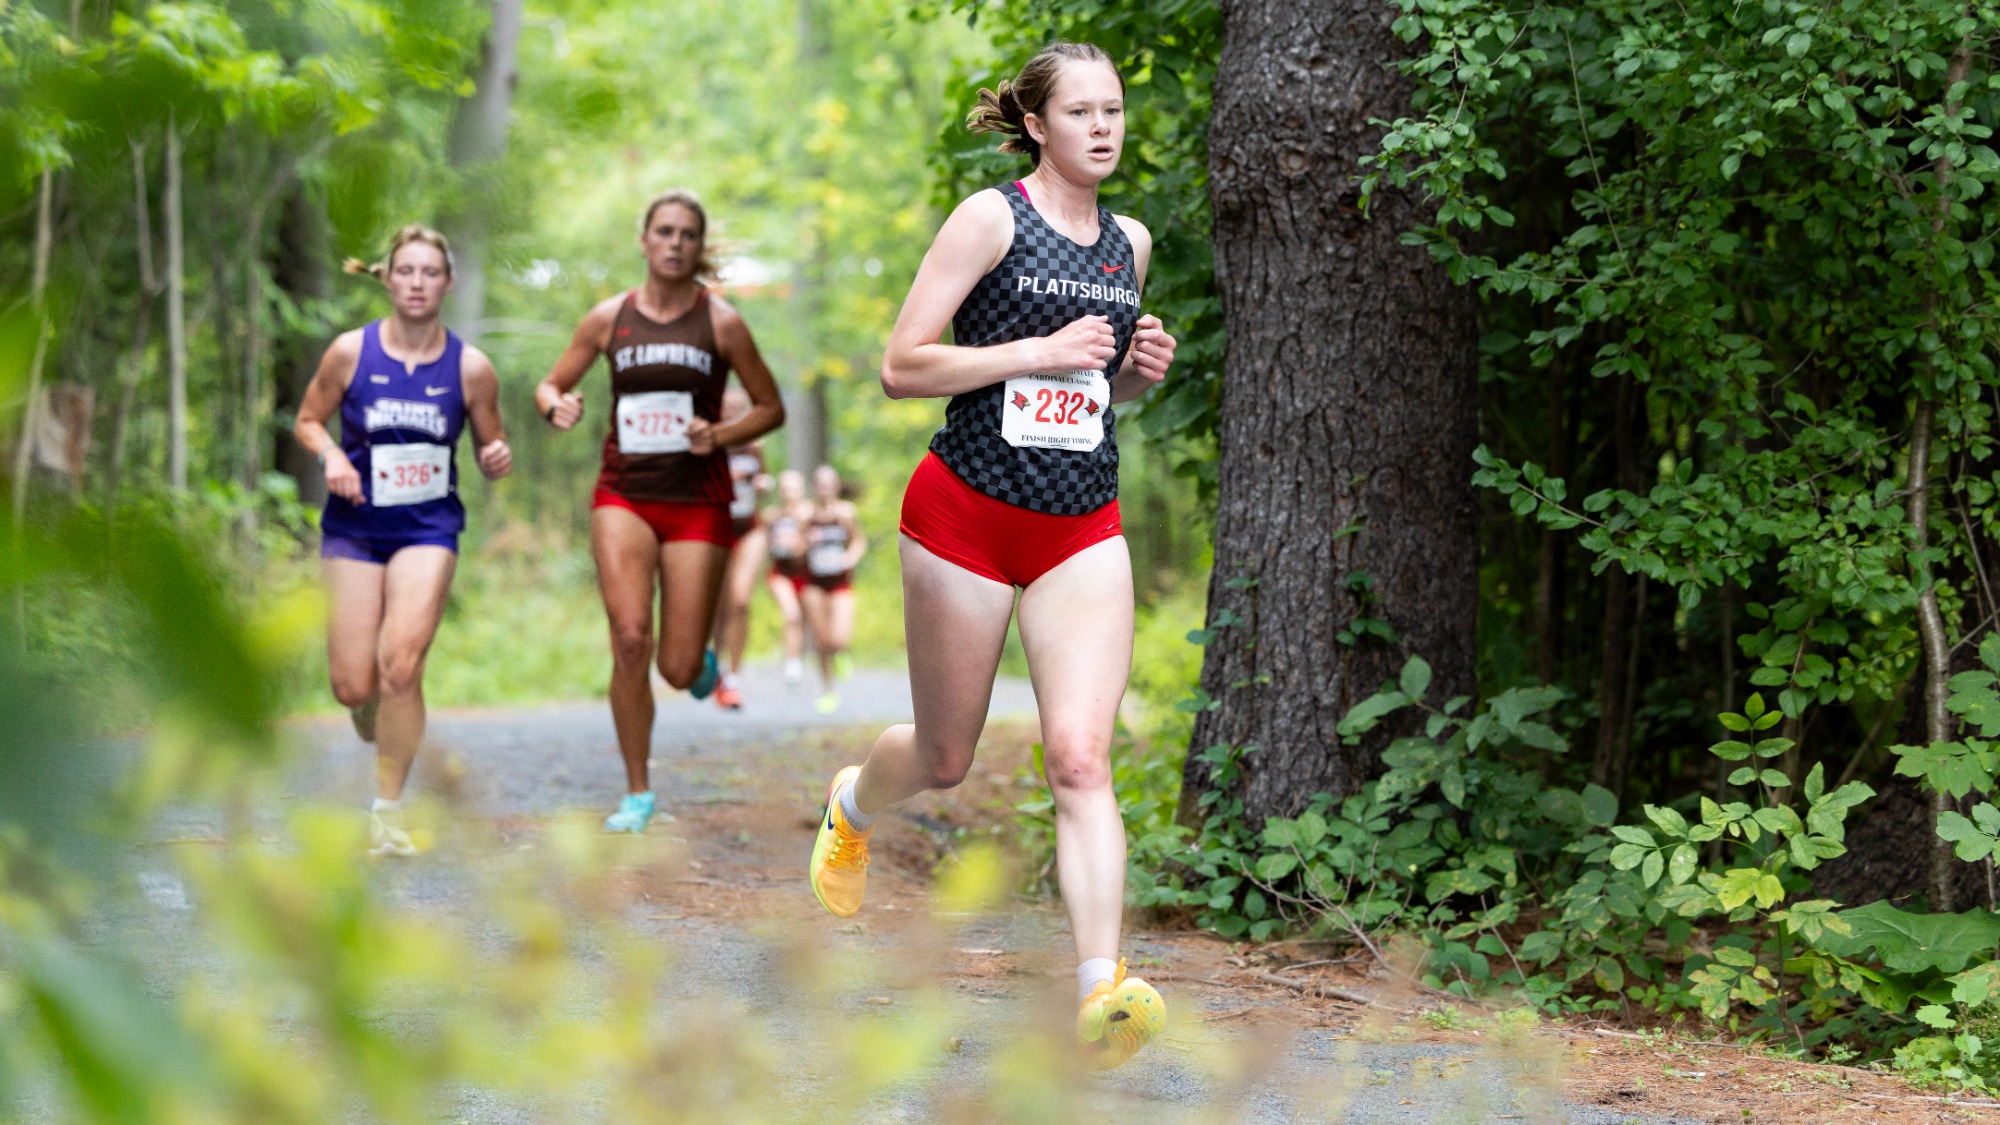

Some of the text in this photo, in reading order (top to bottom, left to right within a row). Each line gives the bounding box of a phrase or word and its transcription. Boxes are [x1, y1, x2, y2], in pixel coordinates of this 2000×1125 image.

[1017, 276, 1140, 309] PLATTSBURGH
[635, 343, 712, 376] LAWRENCE
[1029, 374, 1093, 387] CARDINAL CLASSIC
[1035, 389, 1085, 425] 232
[638, 411, 673, 436] 272
[1021, 434, 1093, 445] FINISH RIGHT TIMING
[394, 463, 430, 488] 326
